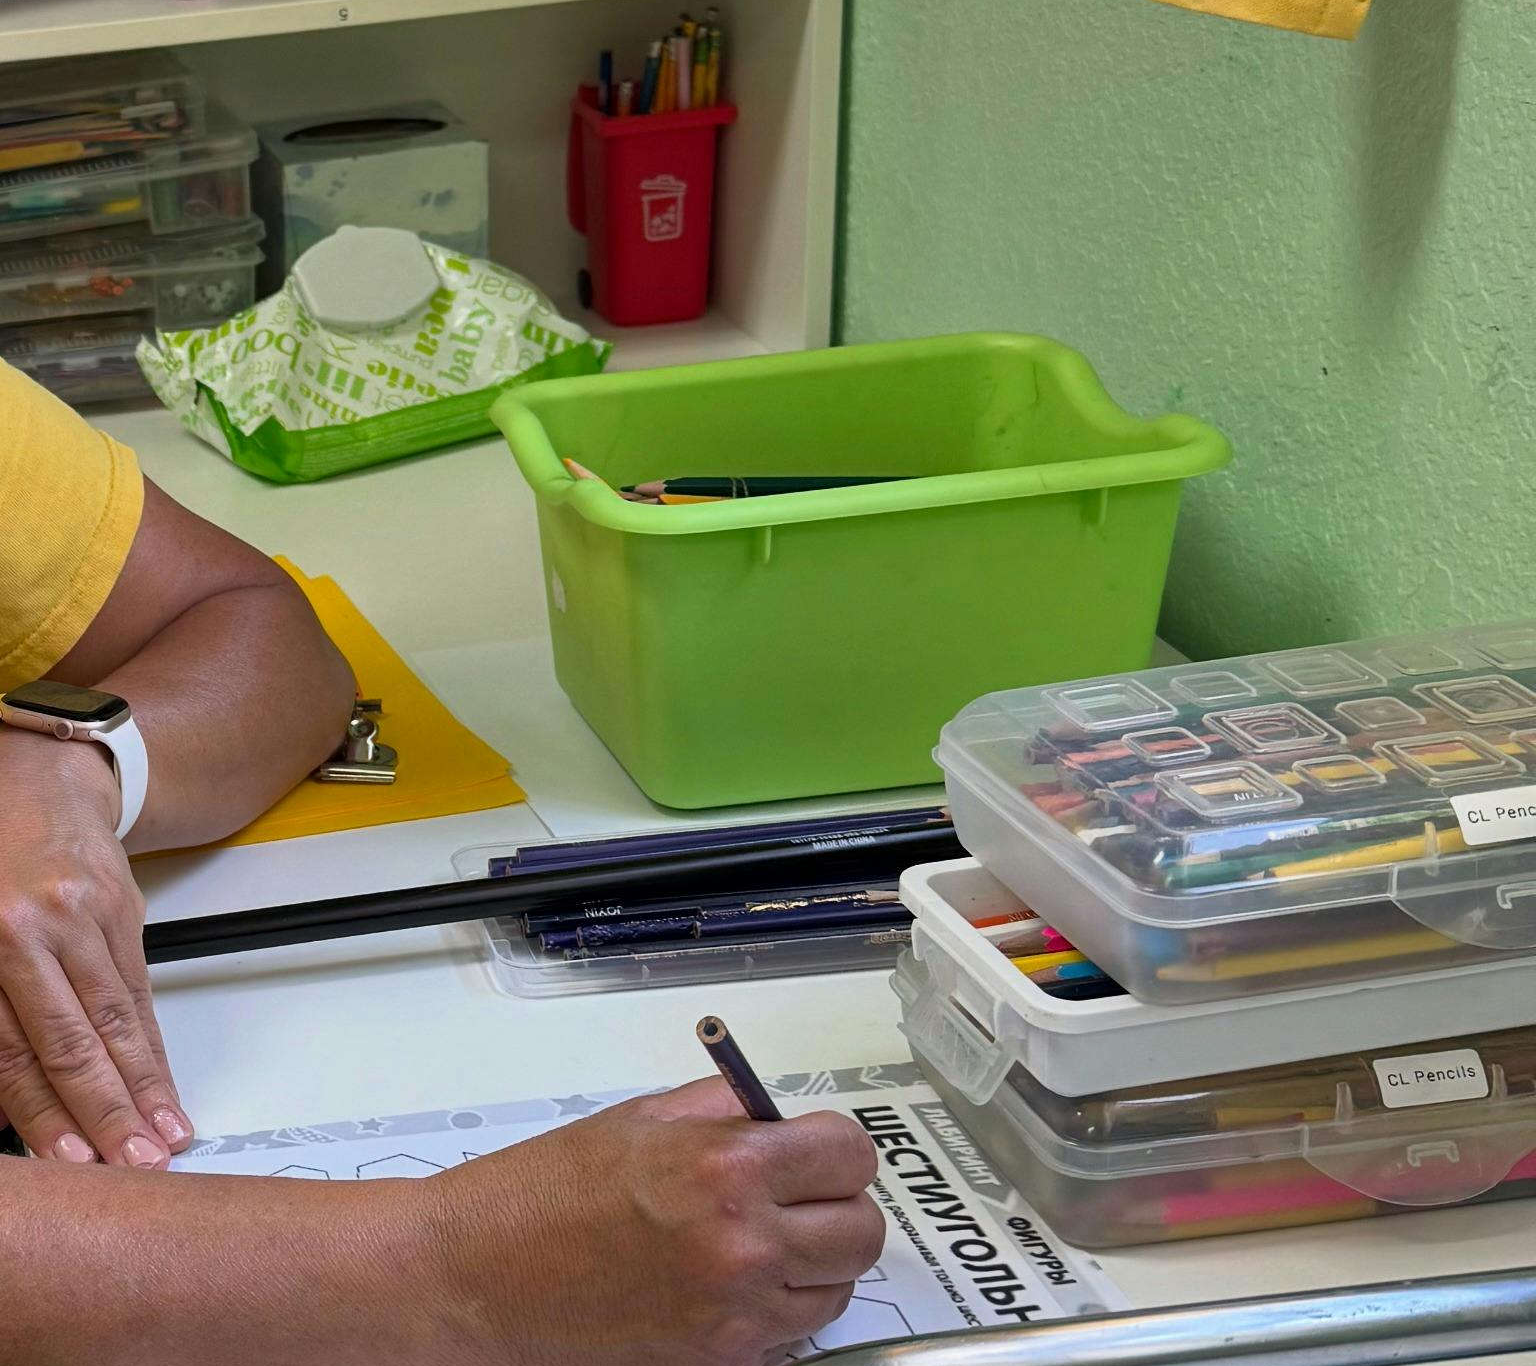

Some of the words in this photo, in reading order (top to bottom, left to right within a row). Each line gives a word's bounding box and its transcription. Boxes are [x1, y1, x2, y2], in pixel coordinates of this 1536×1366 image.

[811, 838, 839, 852] MADE
[839, 838, 847, 850] IN
[846, 834, 876, 848] CHINA
[1467, 809, 1491, 824] CL
[1495, 804, 1536, 820] Penc
[1387, 1072, 1410, 1087] CL
[1414, 1065, 1476, 1083] Pencils
[919, 1107, 1002, 1186] ЛАБИРИНТ
[851, 1105, 1042, 1323] ШЕСТИУГОЛЬН
[886, 1205, 940, 1267] раскрашивая
[933, 1268, 967, 1304] только
[1006, 1216, 1077, 1286] ФИГУРЫ
